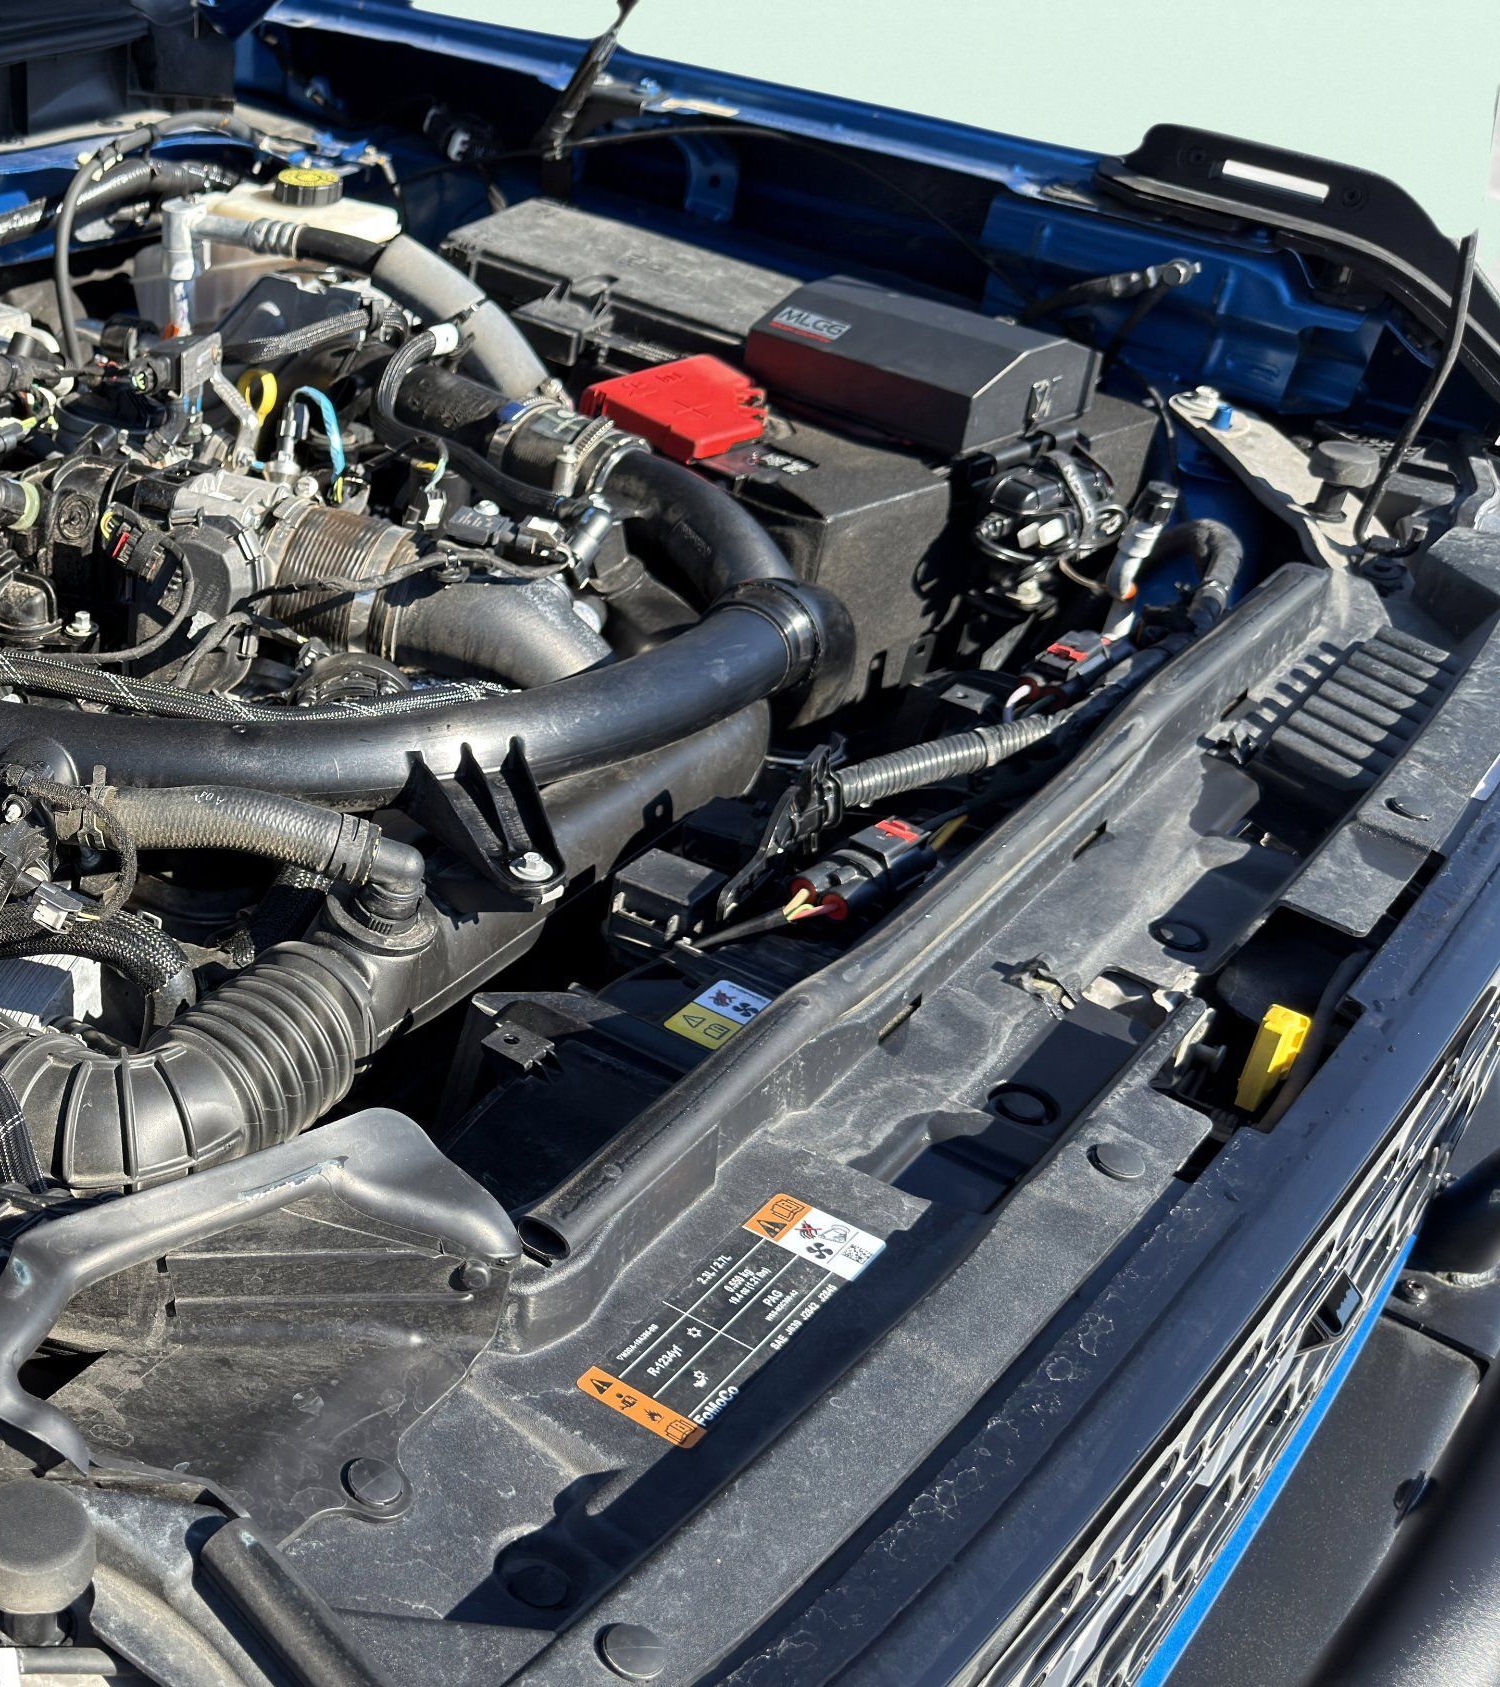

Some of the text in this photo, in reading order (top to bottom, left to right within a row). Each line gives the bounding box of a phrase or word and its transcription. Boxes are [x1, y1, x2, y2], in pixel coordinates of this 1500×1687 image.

[695, 1269, 717, 1285] 2.3L
[714, 1253, 733, 1270] 2.7L
[762, 1288, 785, 1307] PAG
[784, 1320, 803, 1337] J639
[646, 1344, 684, 1377] R-1234yf
[693, 1386, 740, 1427] FoMoCo
